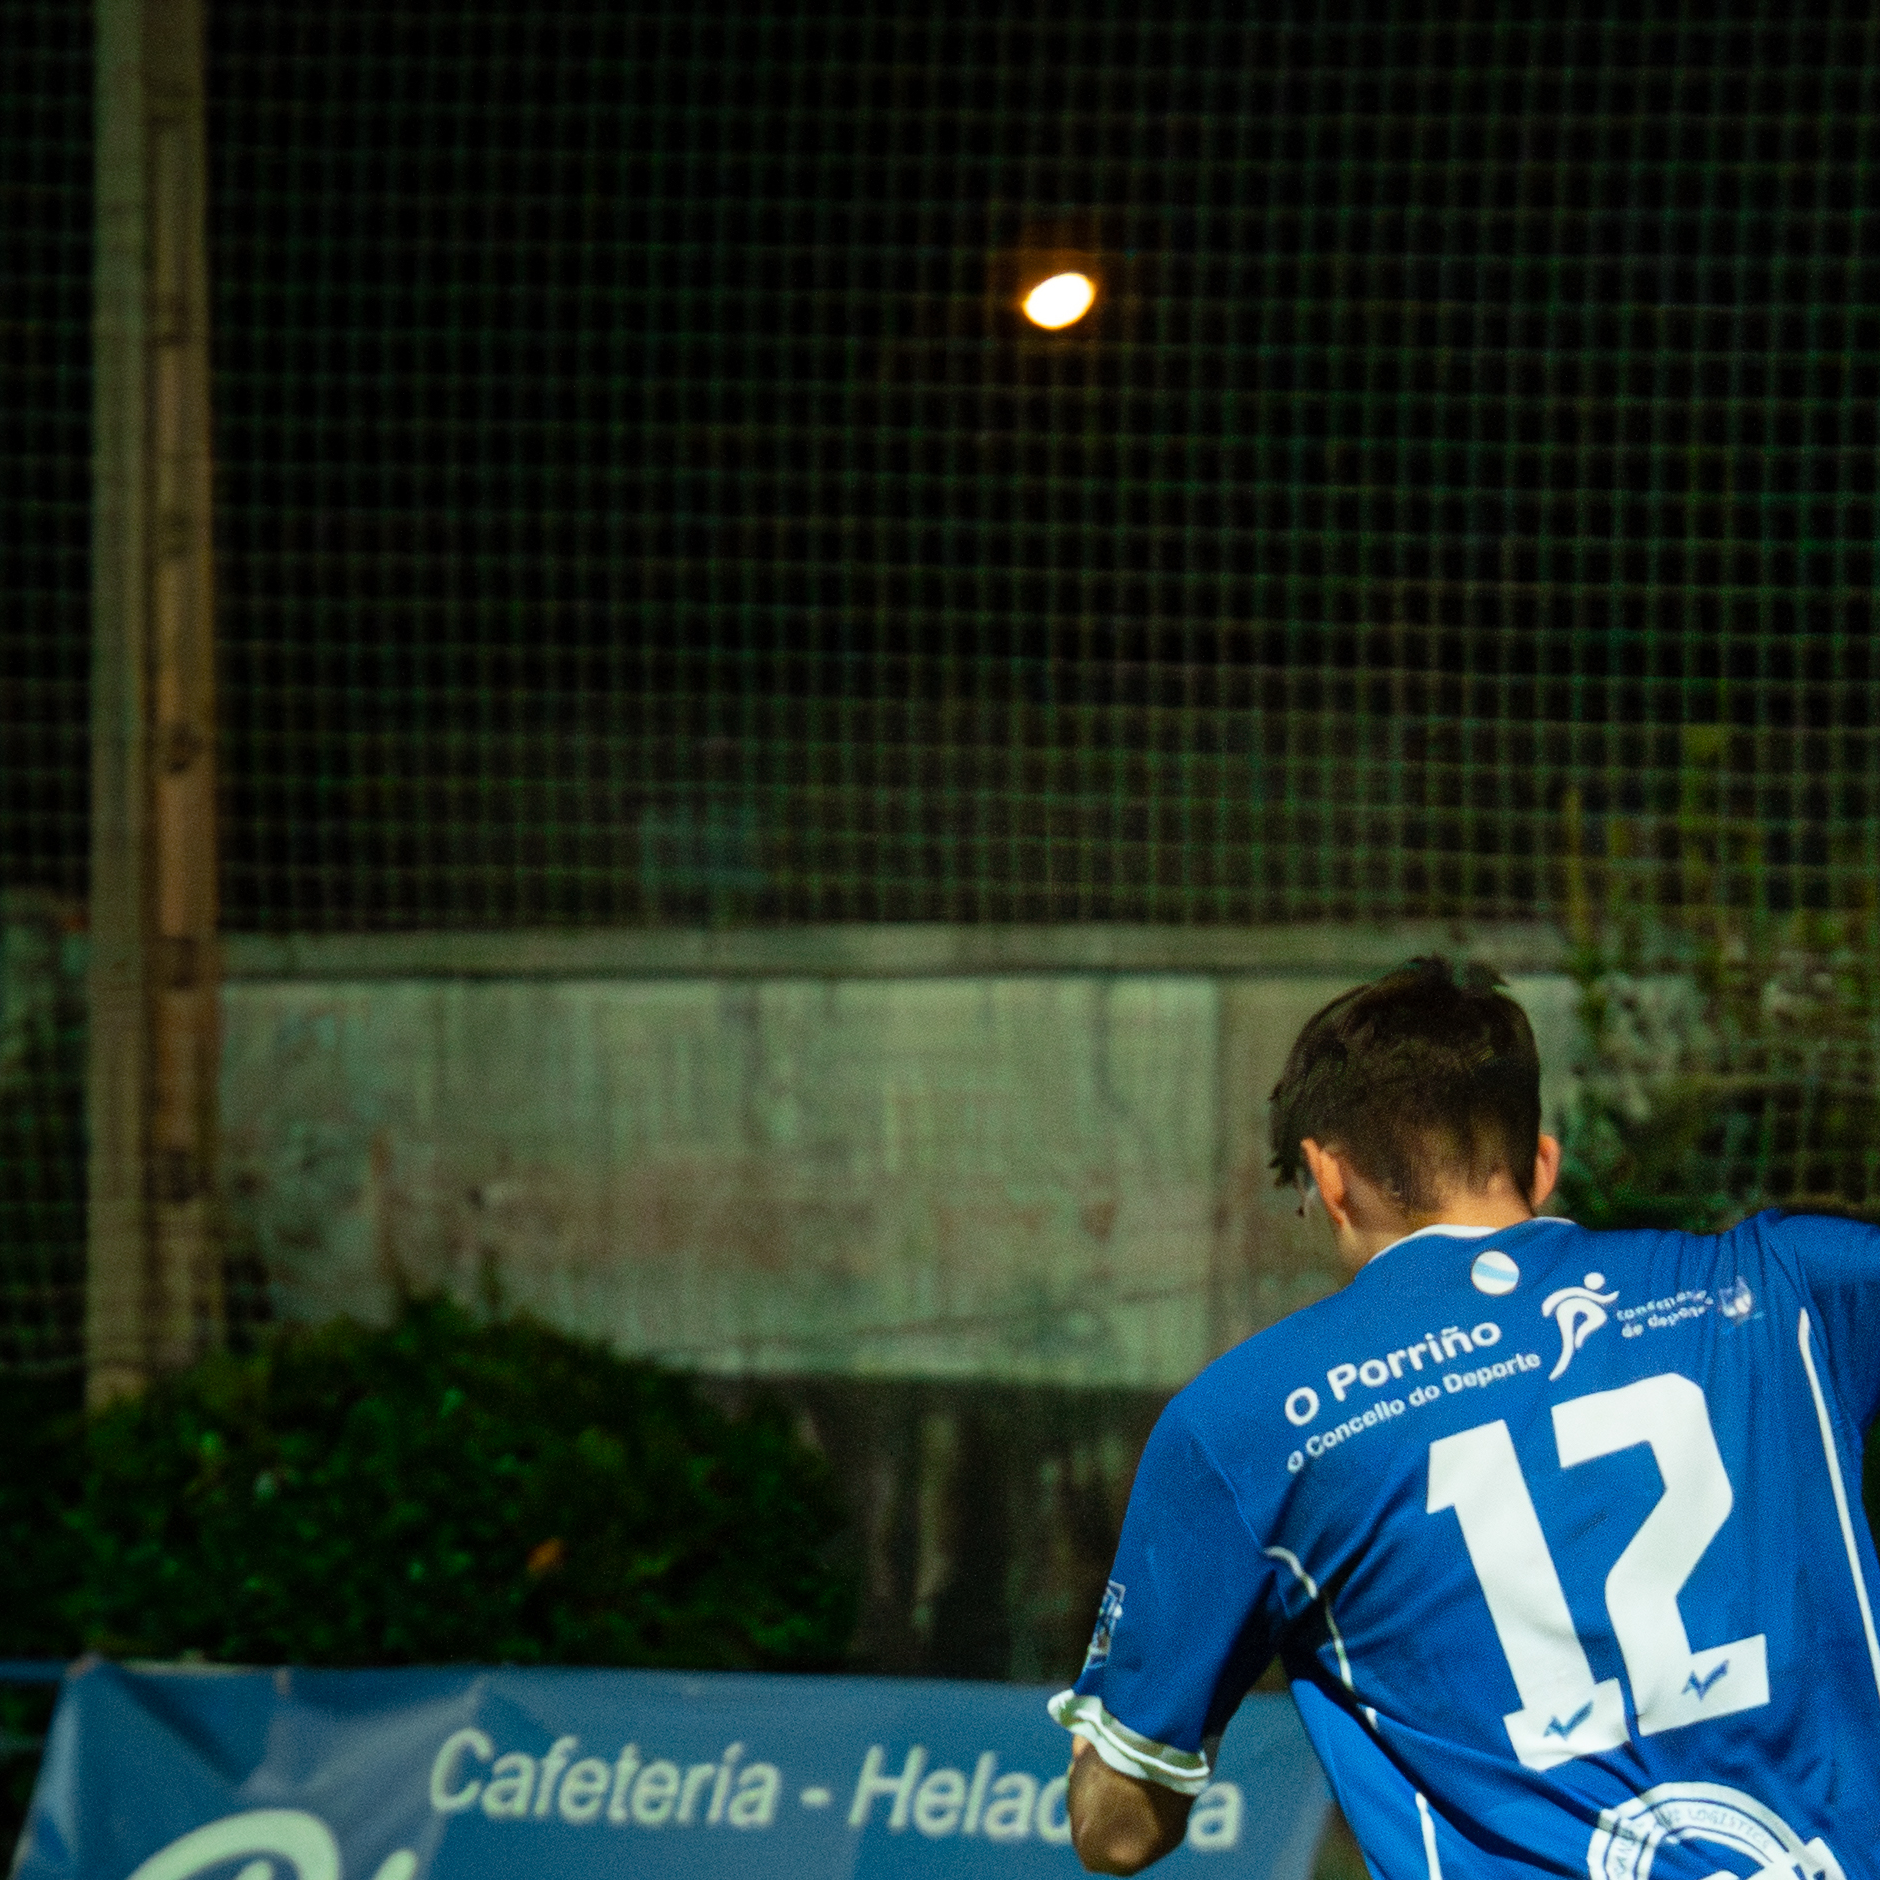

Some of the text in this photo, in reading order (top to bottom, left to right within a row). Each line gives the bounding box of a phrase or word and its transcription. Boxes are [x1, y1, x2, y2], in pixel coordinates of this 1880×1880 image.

[1285, 1322, 1502, 1426] O Porriño
[1305, 1395, 1405, 1458] Concello
[1408, 1379, 1443, 1408] do
[1443, 1351, 1541, 1396] Deporte
[1426, 1373, 1770, 1771] 12
[430, 1728, 780, 1828] Cafetería
